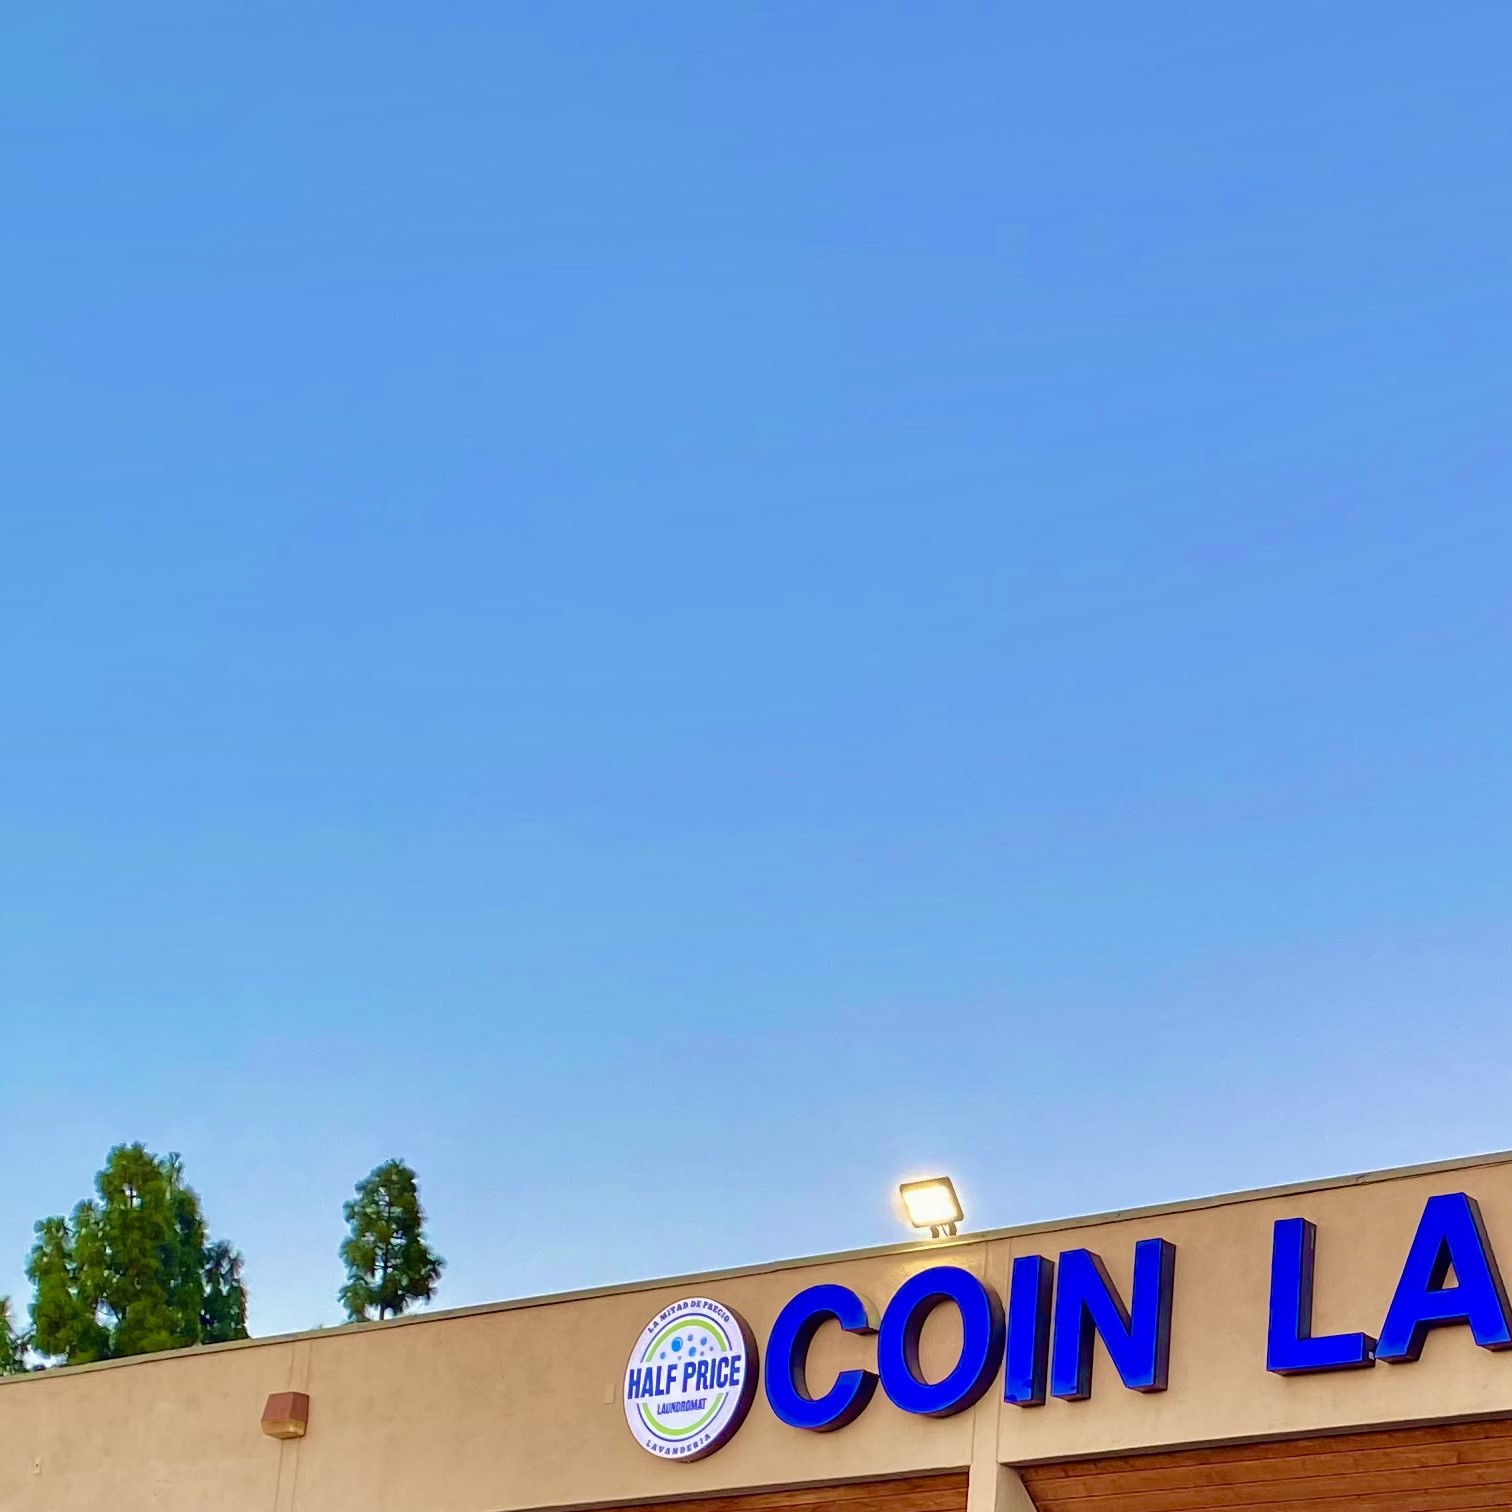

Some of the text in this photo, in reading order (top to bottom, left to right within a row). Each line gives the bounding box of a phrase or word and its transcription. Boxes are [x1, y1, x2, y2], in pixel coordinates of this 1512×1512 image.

[648, 1300, 730, 1333] LA MITAD DE PRECIO
[765, 1238, 1176, 1432] COIN
[627, 1354, 742, 1400] HALF PRICE
[657, 1398, 707, 1415] LAUNDROMAT
